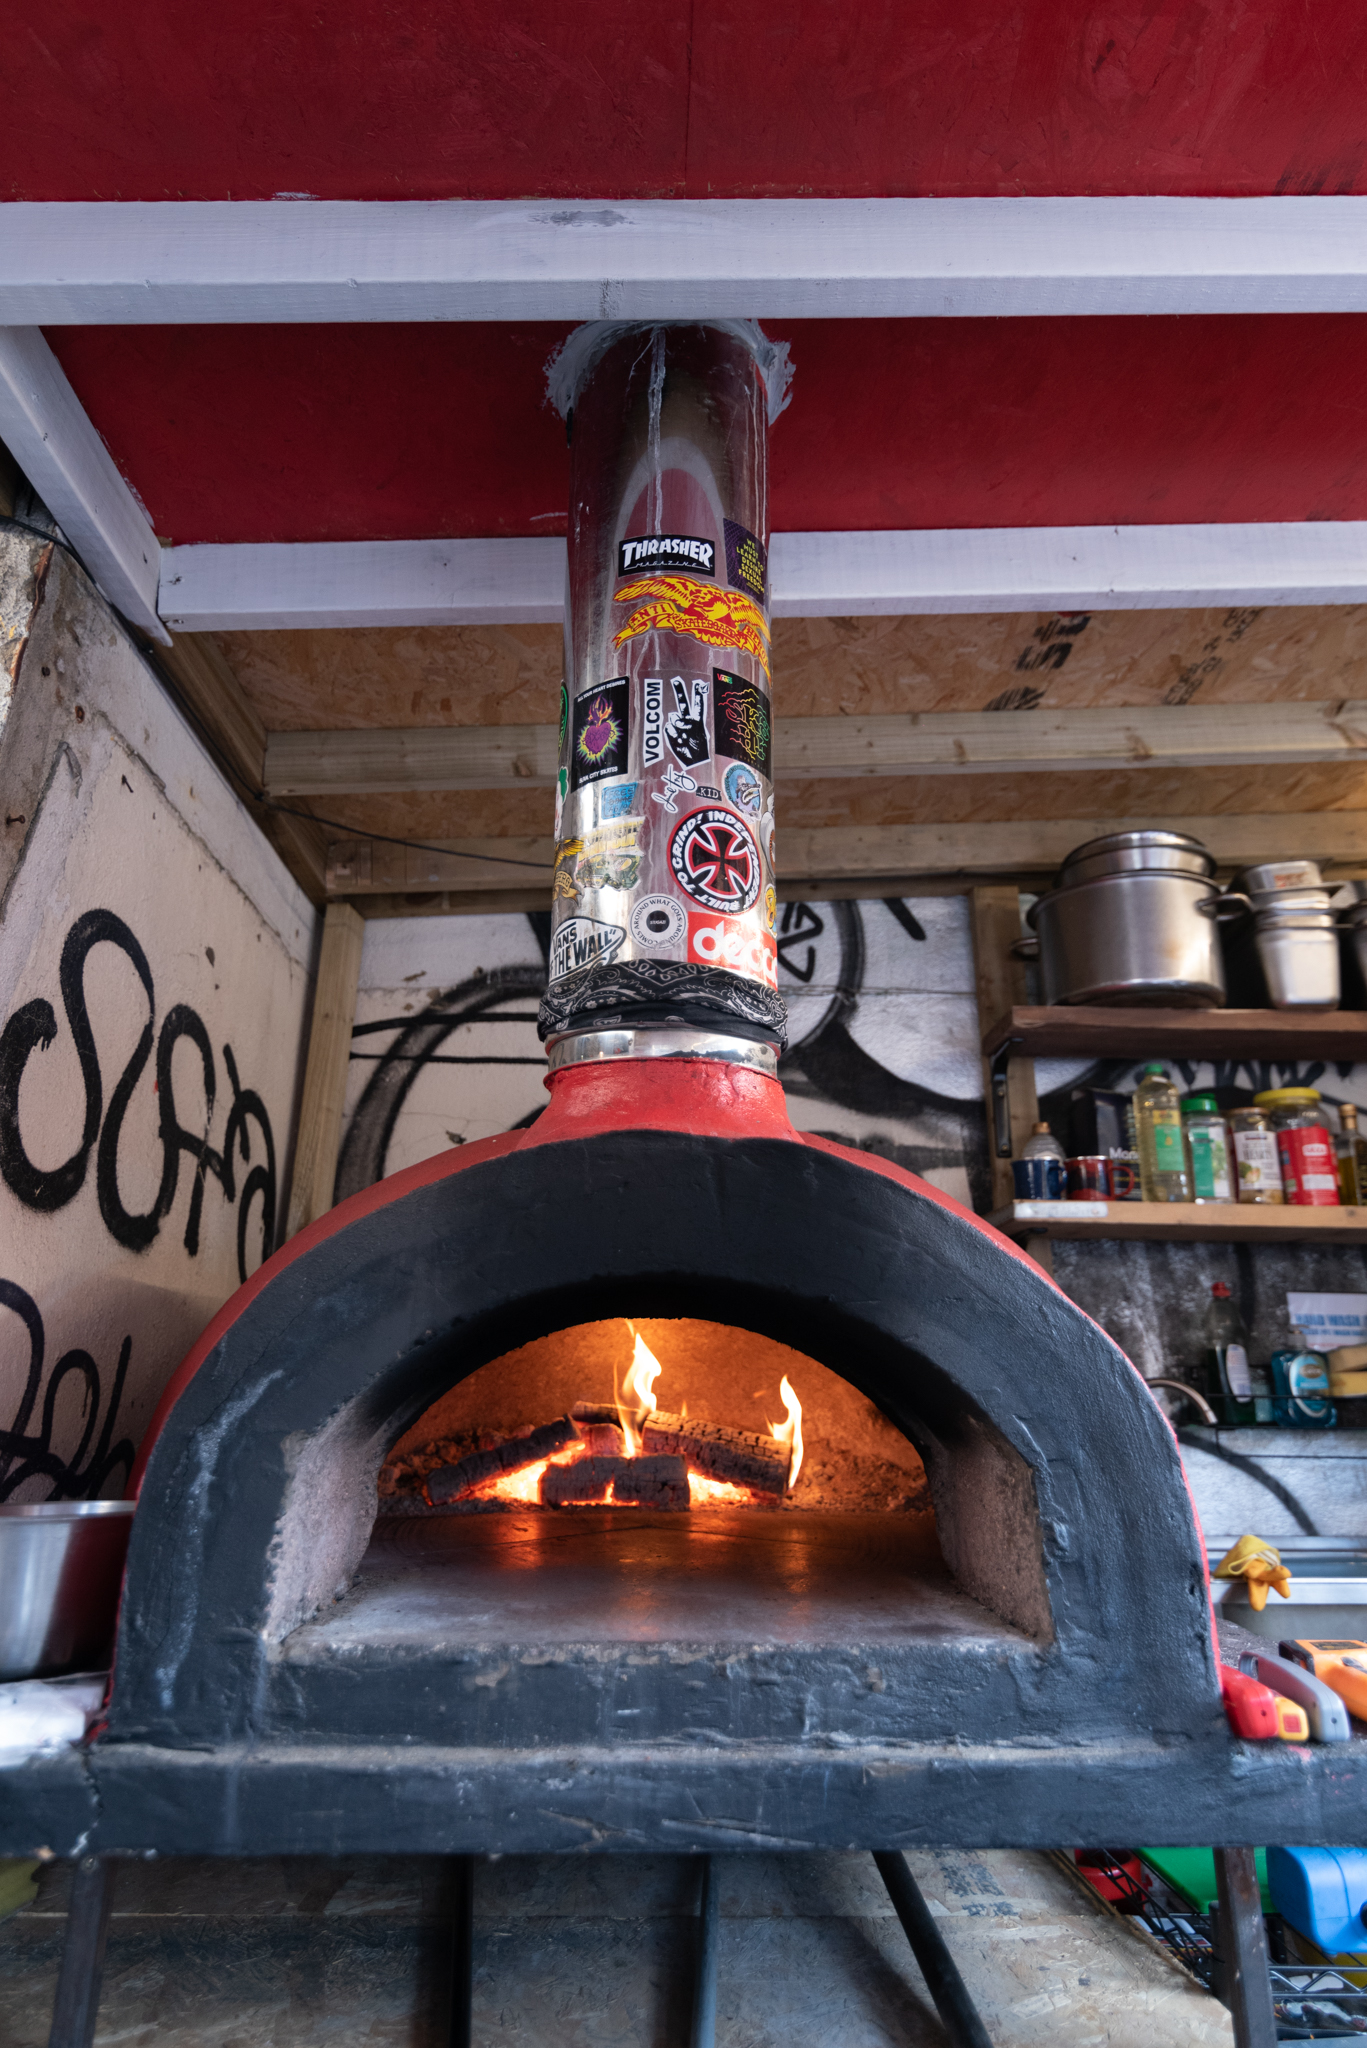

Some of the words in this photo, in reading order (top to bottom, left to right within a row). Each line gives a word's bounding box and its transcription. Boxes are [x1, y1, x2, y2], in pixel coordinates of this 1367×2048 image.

[622, 538, 713, 568] THRASHER
[743, 543, 759, 559] MUST
[747, 538, 755, 549] WE
[636, 560, 698, 568] MAGAZINE
[736, 546, 757, 564] LEARN
[757, 561, 764, 571] TO
[741, 556, 762, 576] DESIRE
[738, 568, 765, 593] FREEDOM
[741, 563, 763, 584] SEXUAL
[628, 602, 668, 628] ANTI
[583, 690, 593, 699] YOUR
[592, 684, 607, 694] HEART
[645, 682, 661, 763] VOLCOM
[589, 770, 600, 780] CITY
[600, 765, 618, 777] SKATES
[700, 787, 719, 798] KID
[672, 813, 703, 869] GRIND!
[677, 871, 697, 894] TO
[670, 904, 683, 922] GOES
[694, 894, 740, 911] BUILT
[634, 902, 650, 930] AROUND
[554, 944, 572, 976] THE
